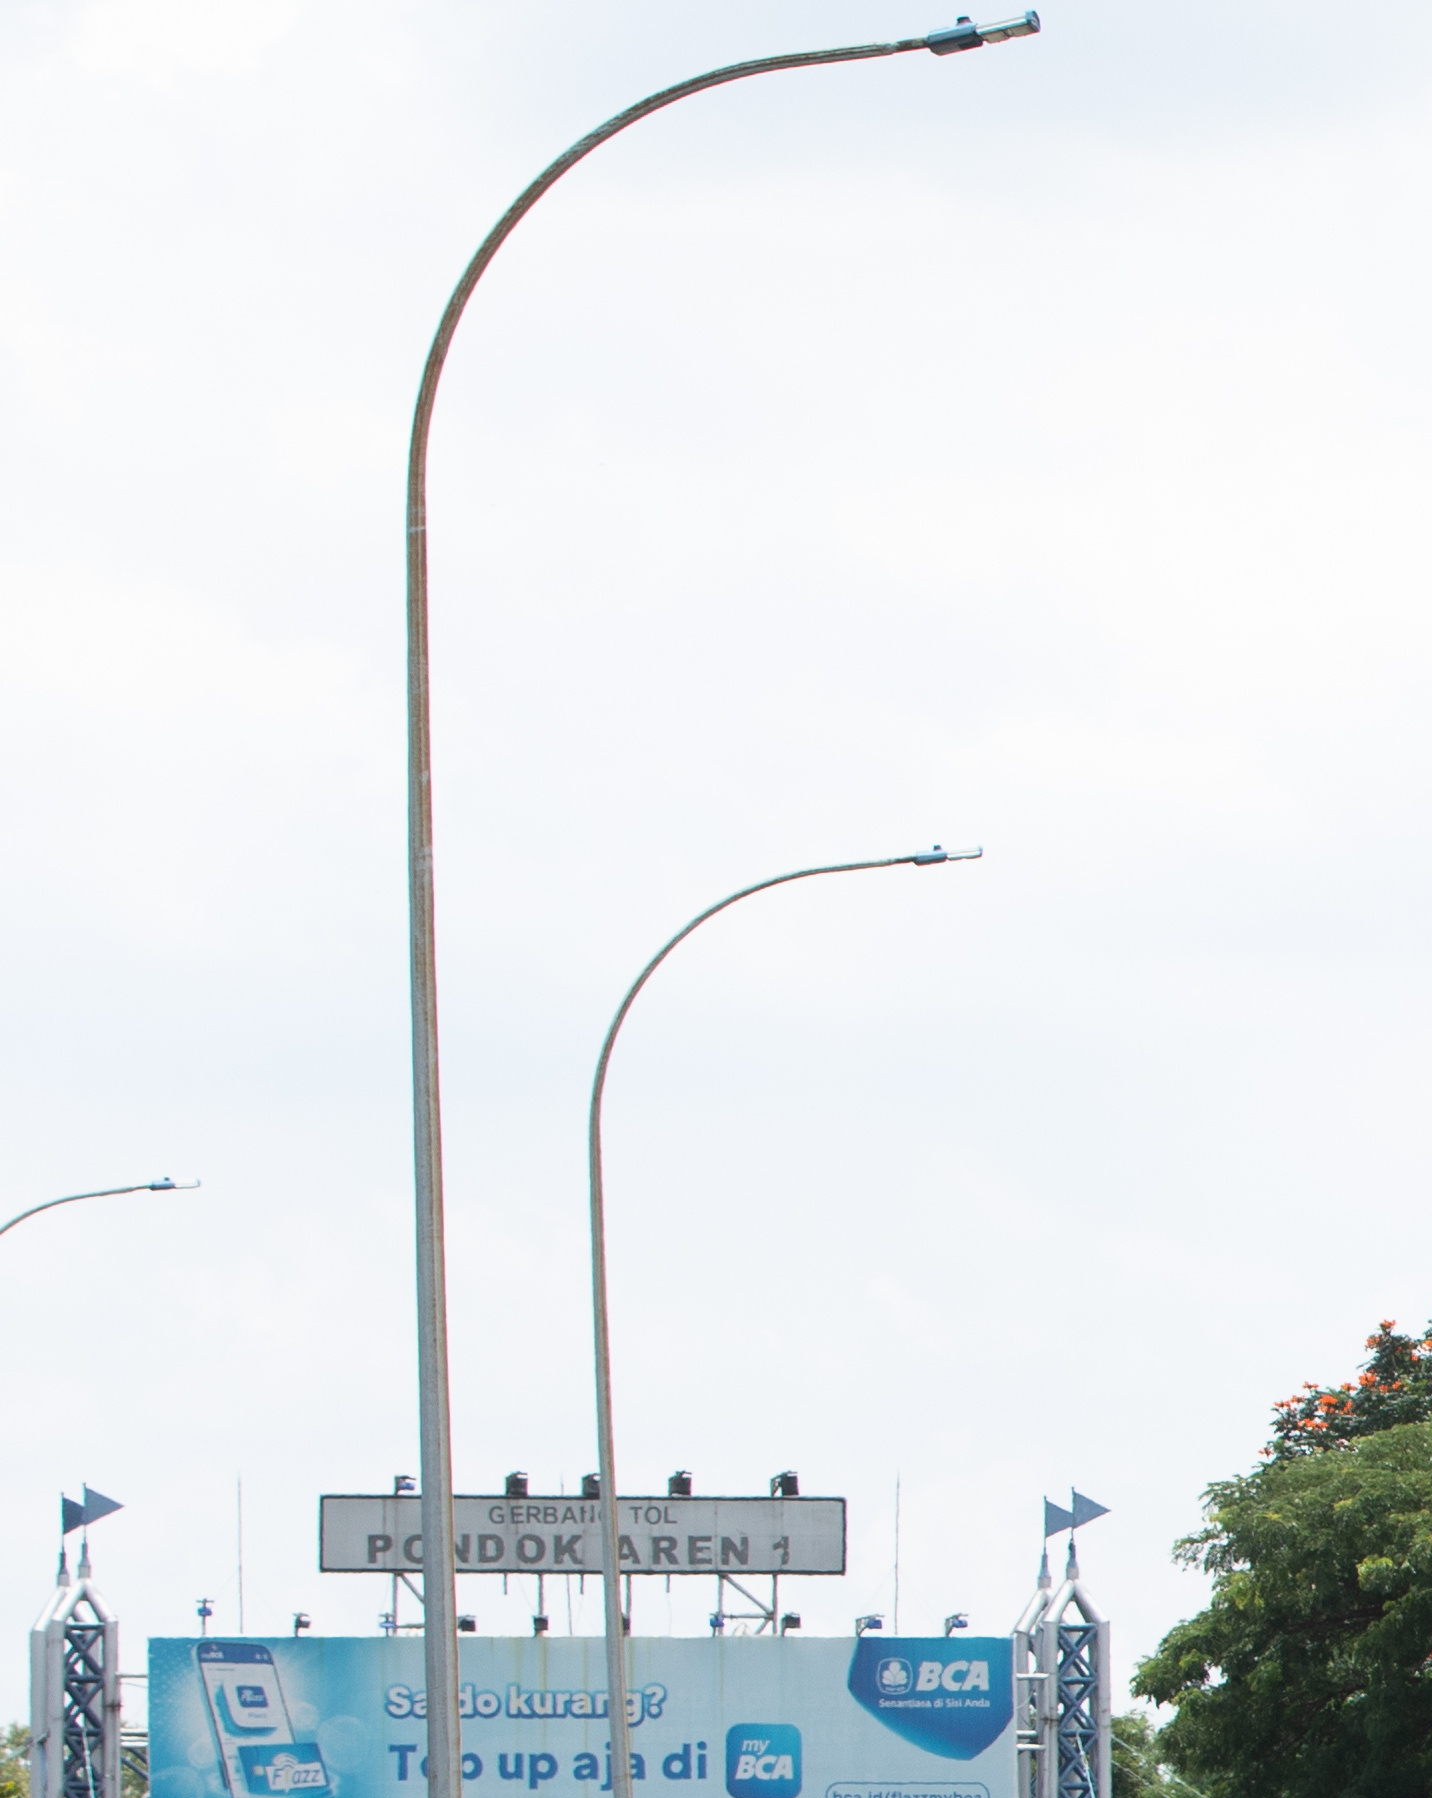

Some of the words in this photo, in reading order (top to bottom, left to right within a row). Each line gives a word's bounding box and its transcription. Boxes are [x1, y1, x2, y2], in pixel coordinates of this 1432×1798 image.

[488, 1504, 604, 1526] GERBAN
[629, 1505, 678, 1525] TOL
[915, 1659, 991, 1692] BCA
[385, 1682, 501, 1720] Sado
[741, 1738, 770, 1755] my
[498, 1751, 559, 1790] up
[661, 1741, 708, 1781] di
[734, 1754, 795, 1781] BCA
